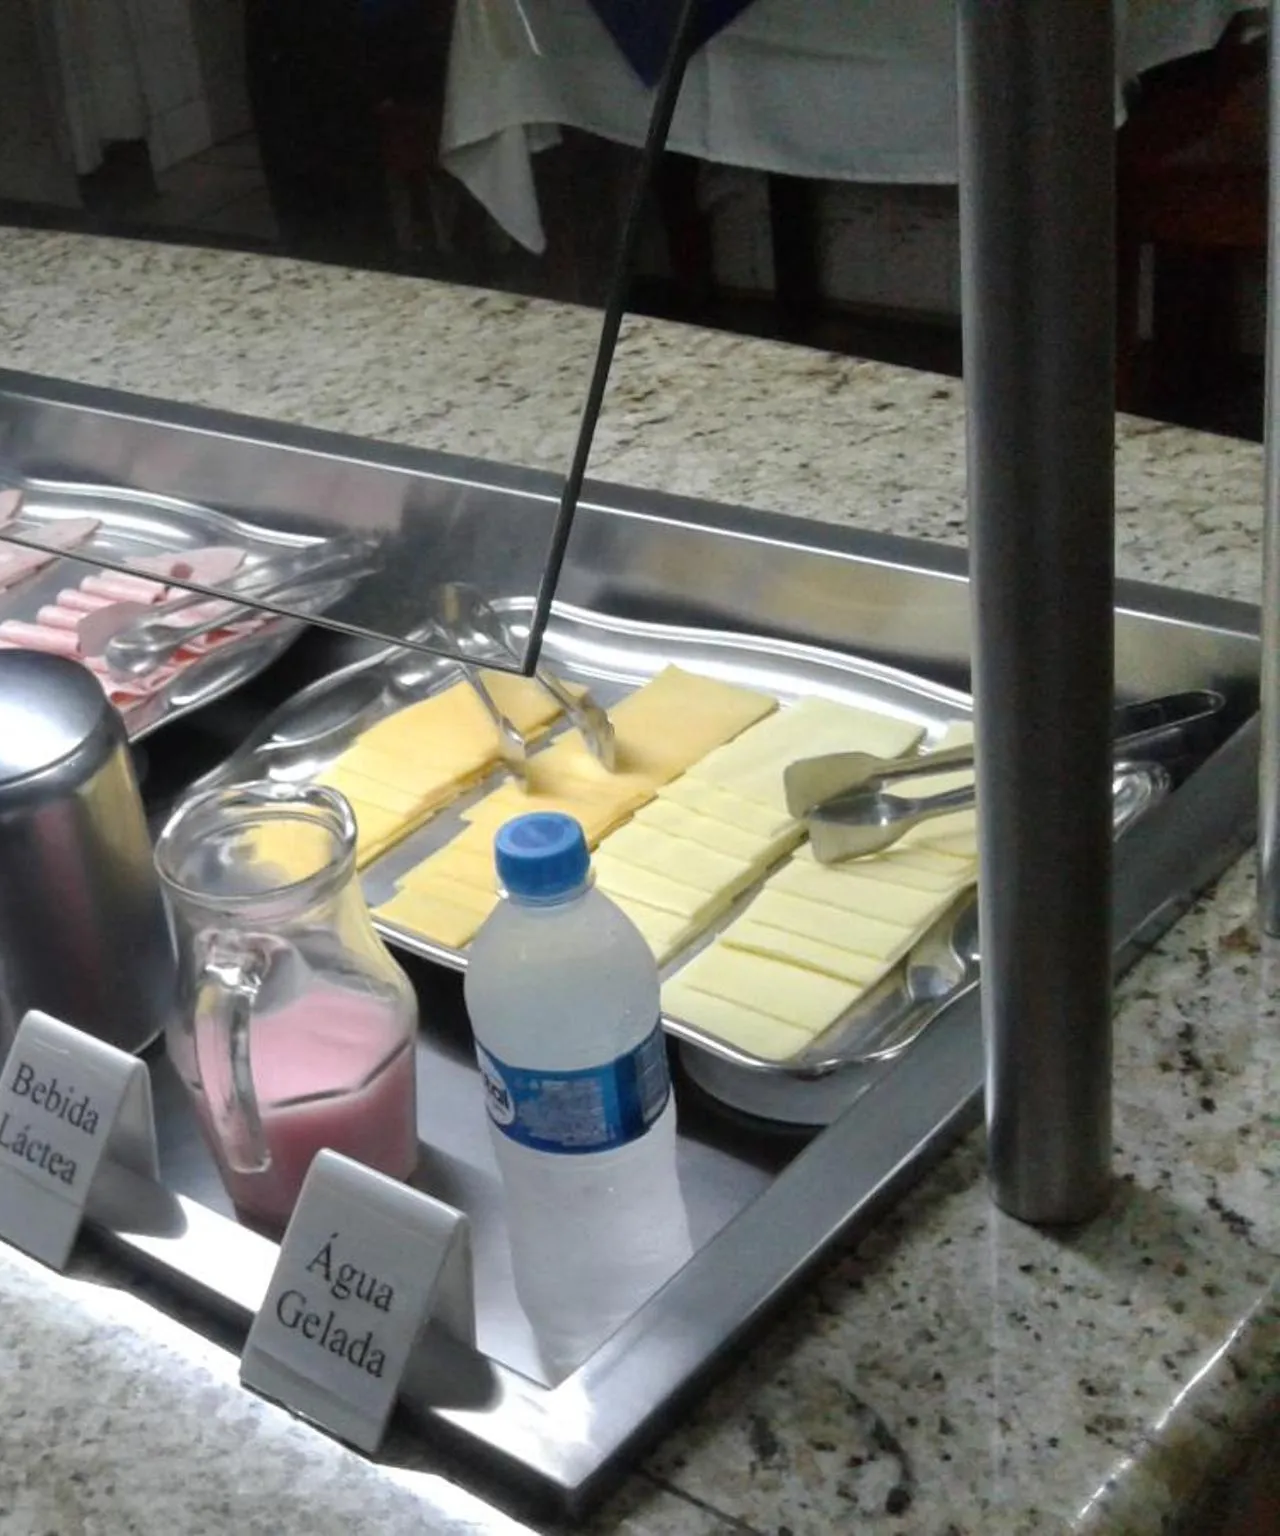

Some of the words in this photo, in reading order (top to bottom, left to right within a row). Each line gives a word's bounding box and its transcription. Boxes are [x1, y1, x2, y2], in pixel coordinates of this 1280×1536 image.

[10, 1063, 100, 1136] Bebida
[305, 1232, 395, 1313] Água
[276, 1288, 387, 1380] Gelada
